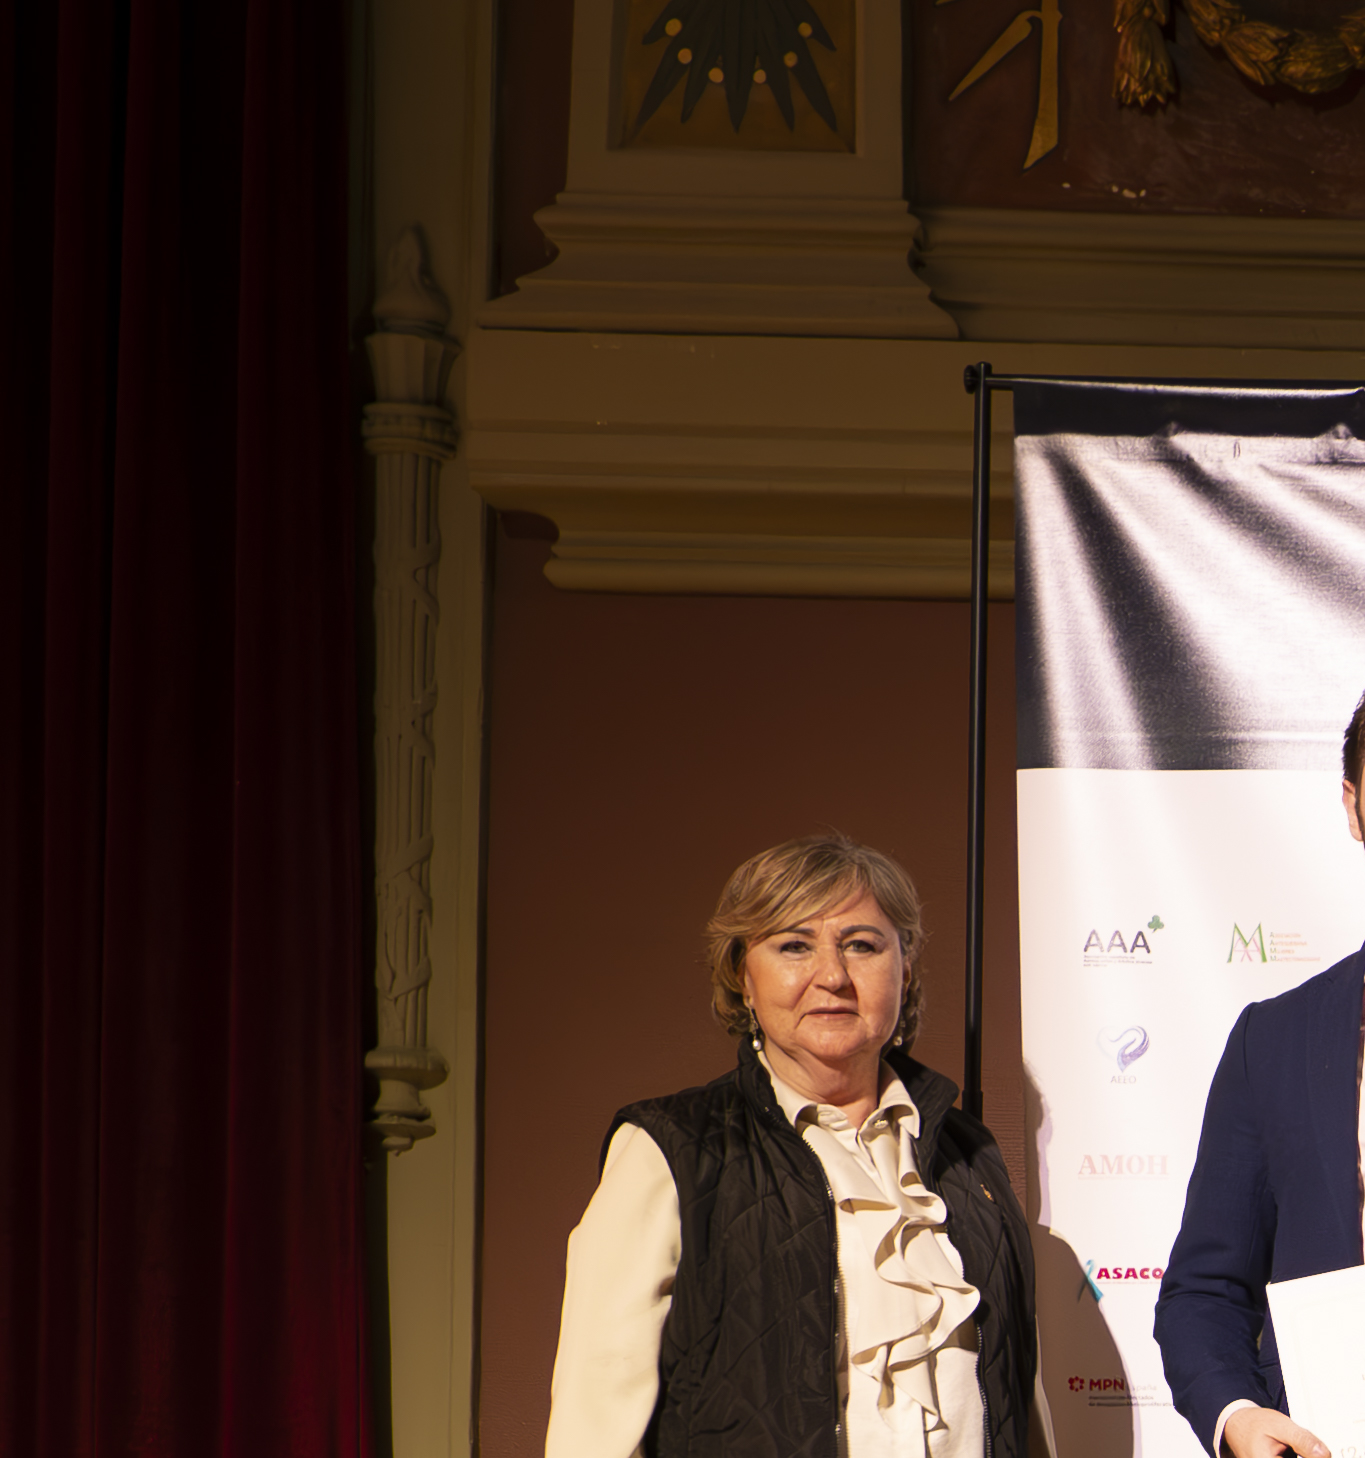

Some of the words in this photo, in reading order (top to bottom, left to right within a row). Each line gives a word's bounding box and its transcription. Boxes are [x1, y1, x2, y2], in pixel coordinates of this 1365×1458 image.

[1083, 929, 1152, 954] AAA
[1078, 1154, 1170, 1176] AMOH
[1096, 1267, 1165, 1280] ASACO
[1090, 1378, 1125, 1391] MPN
